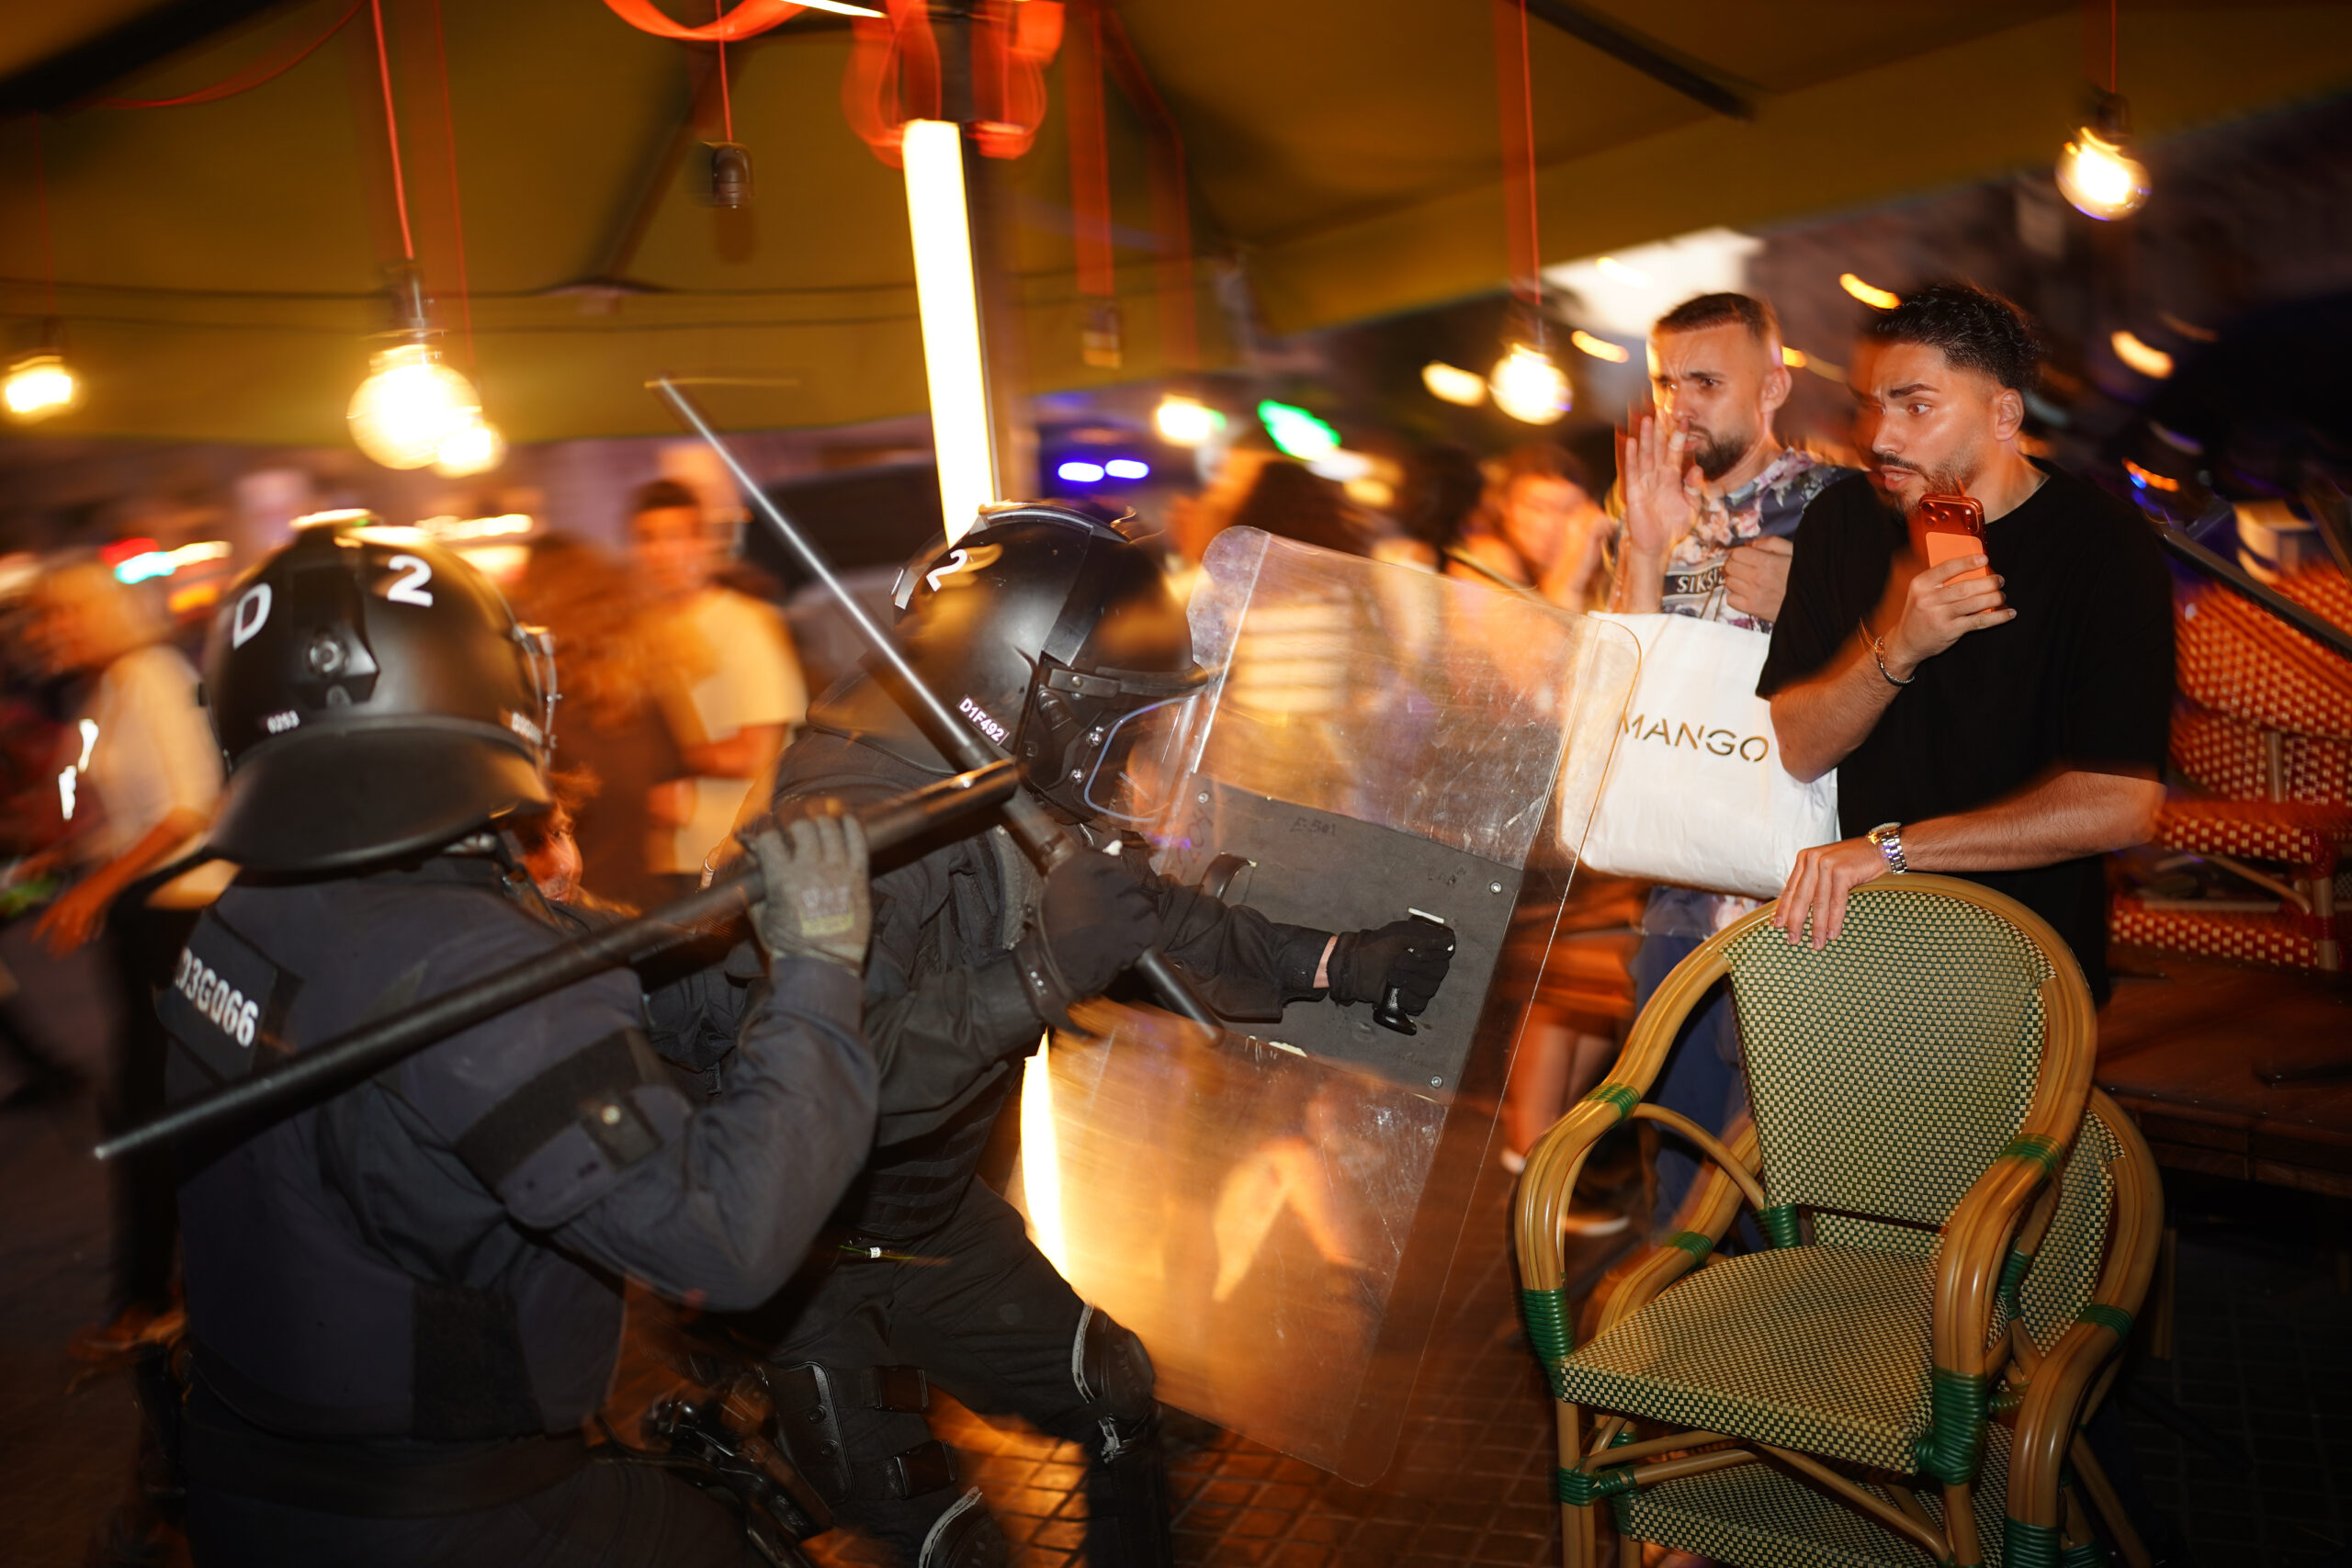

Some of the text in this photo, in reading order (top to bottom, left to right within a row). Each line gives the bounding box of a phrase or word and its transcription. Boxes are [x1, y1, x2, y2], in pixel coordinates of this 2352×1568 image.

[387, 555, 434, 607] 2
[926, 549, 967, 592] 2
[959, 698, 1004, 741] D1F492
[1617, 713, 1770, 762] MANGO
